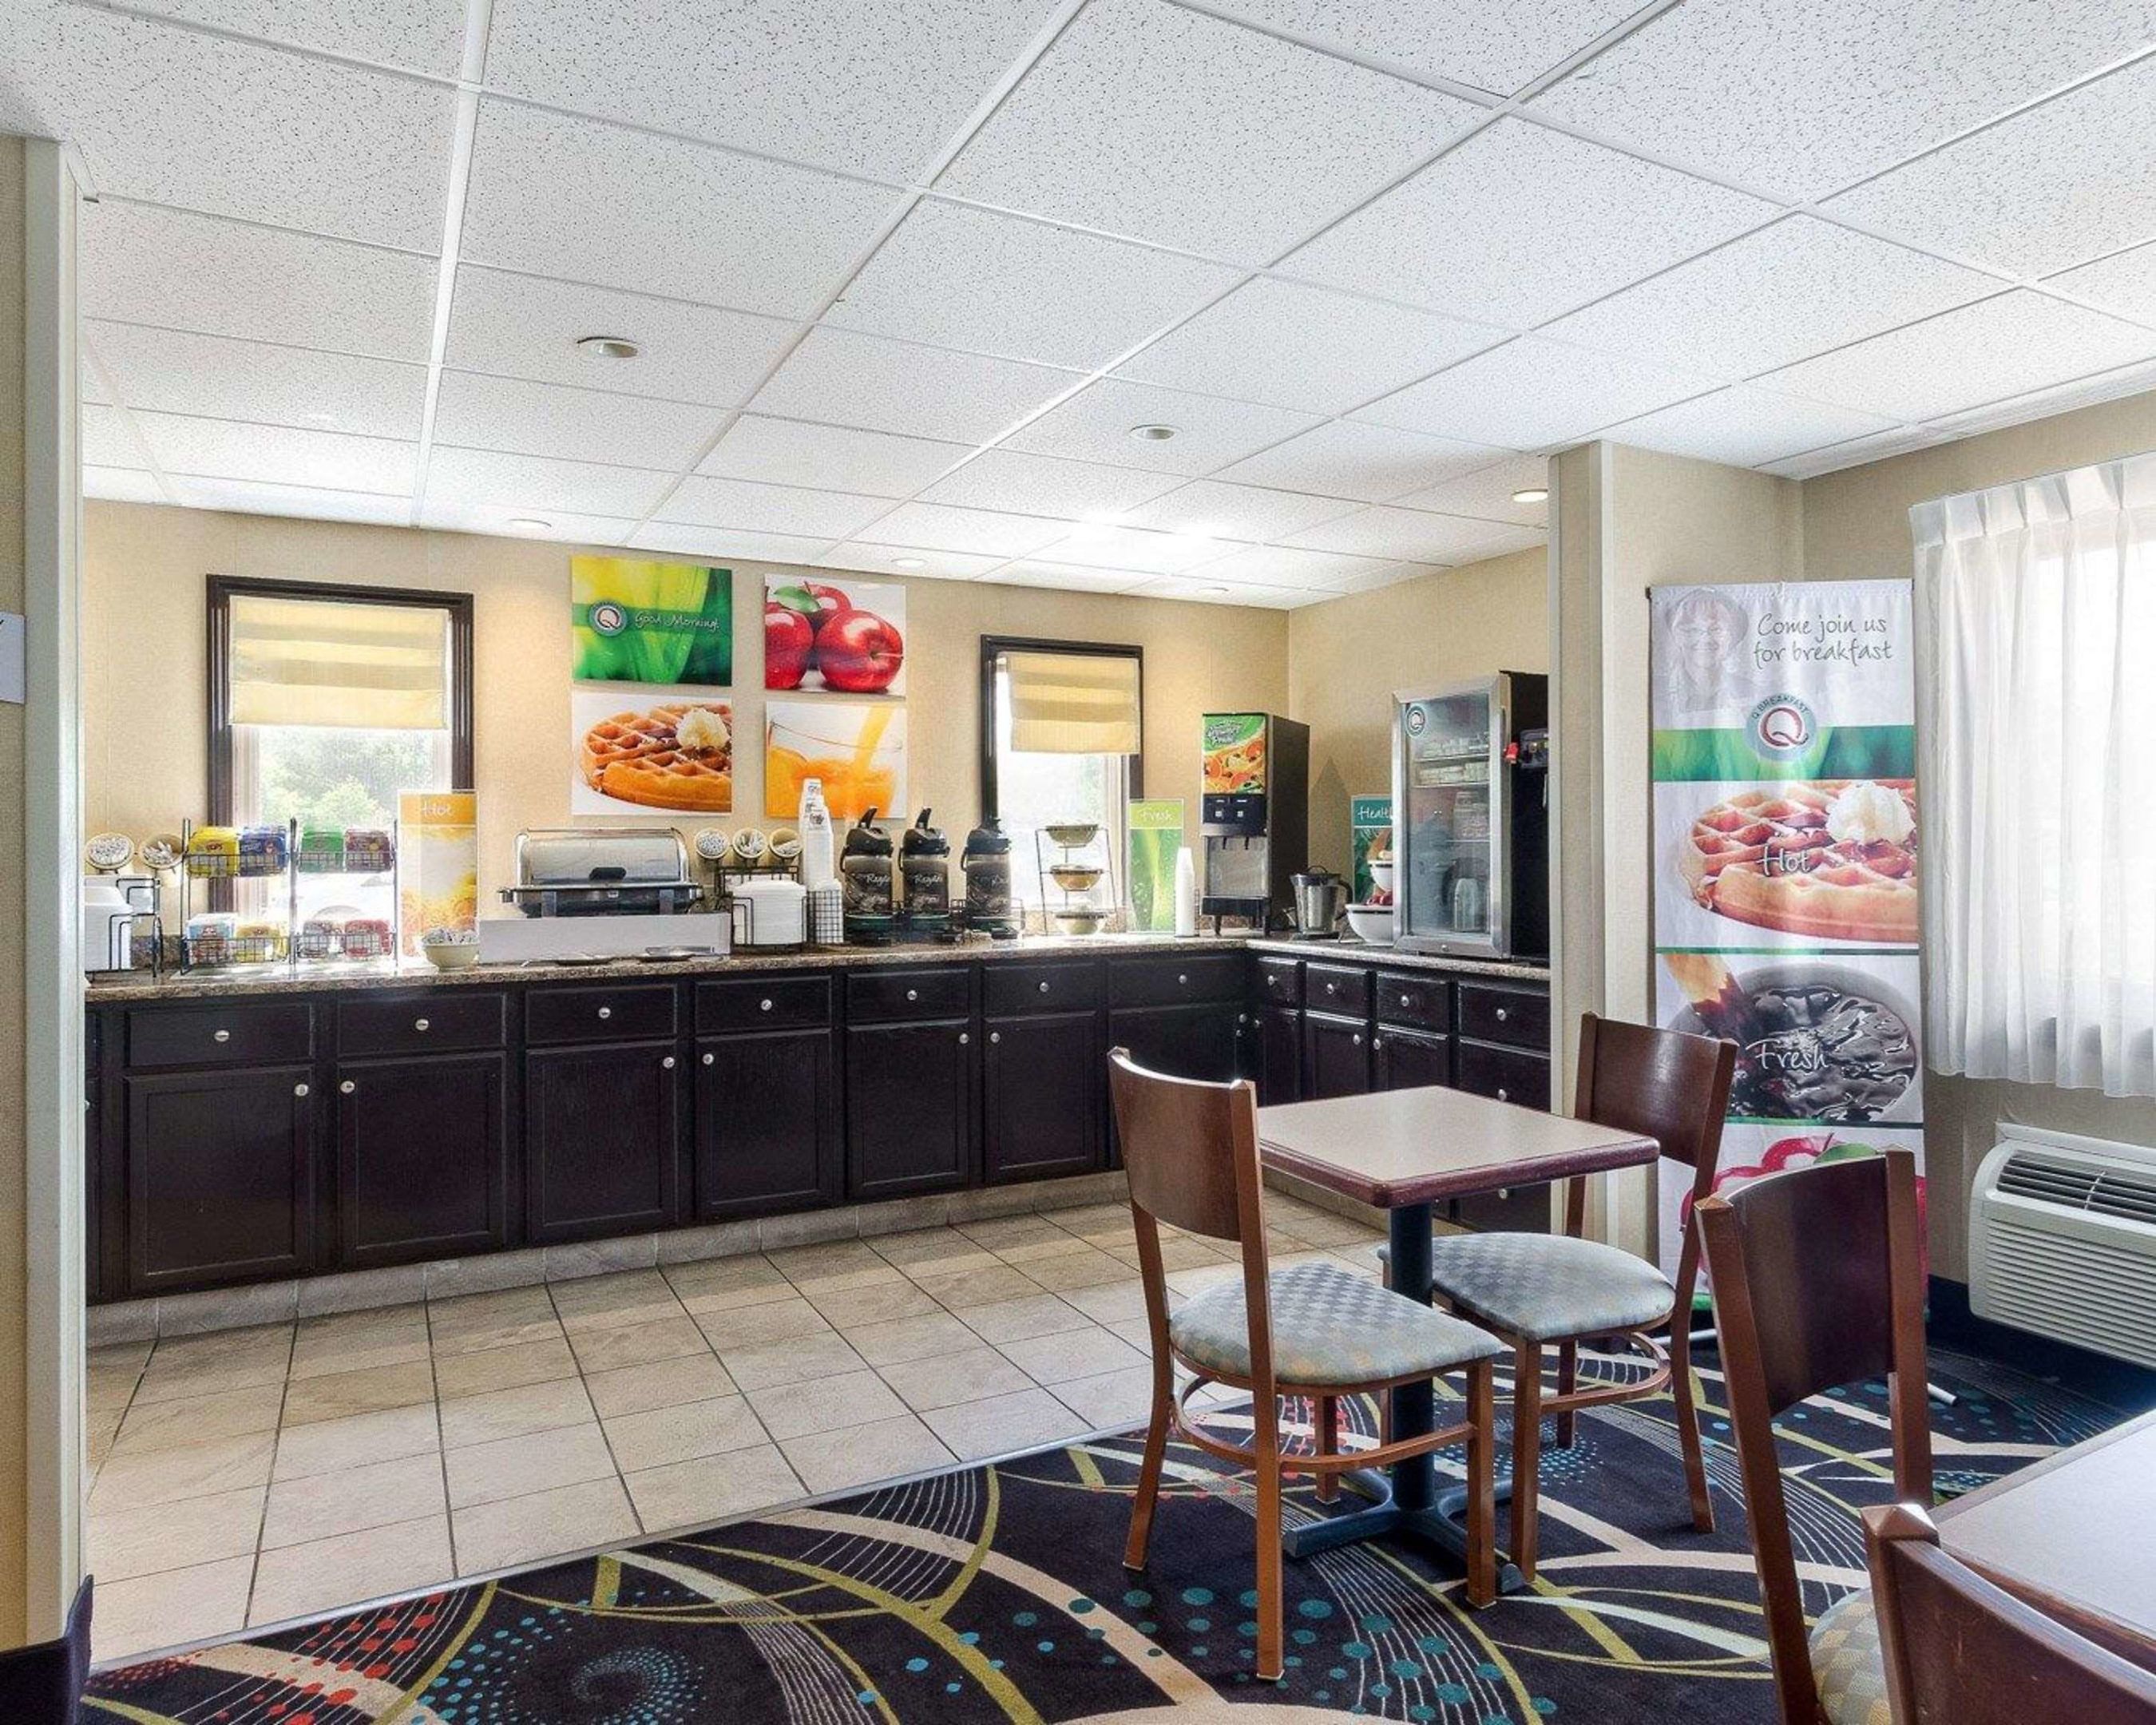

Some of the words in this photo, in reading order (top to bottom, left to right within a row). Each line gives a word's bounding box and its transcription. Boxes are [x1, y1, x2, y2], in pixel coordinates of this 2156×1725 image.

[635, 610, 662, 629] Good
[1758, 613, 1813, 636] Come
[1814, 614, 1857, 644] join
[1864, 618, 1887, 633] us
[1754, 640, 1785, 670] for
[1792, 638, 1892, 668] breakfast
[1757, 845, 1812, 877] Hot
[1746, 1037, 1829, 1071] Fresh
